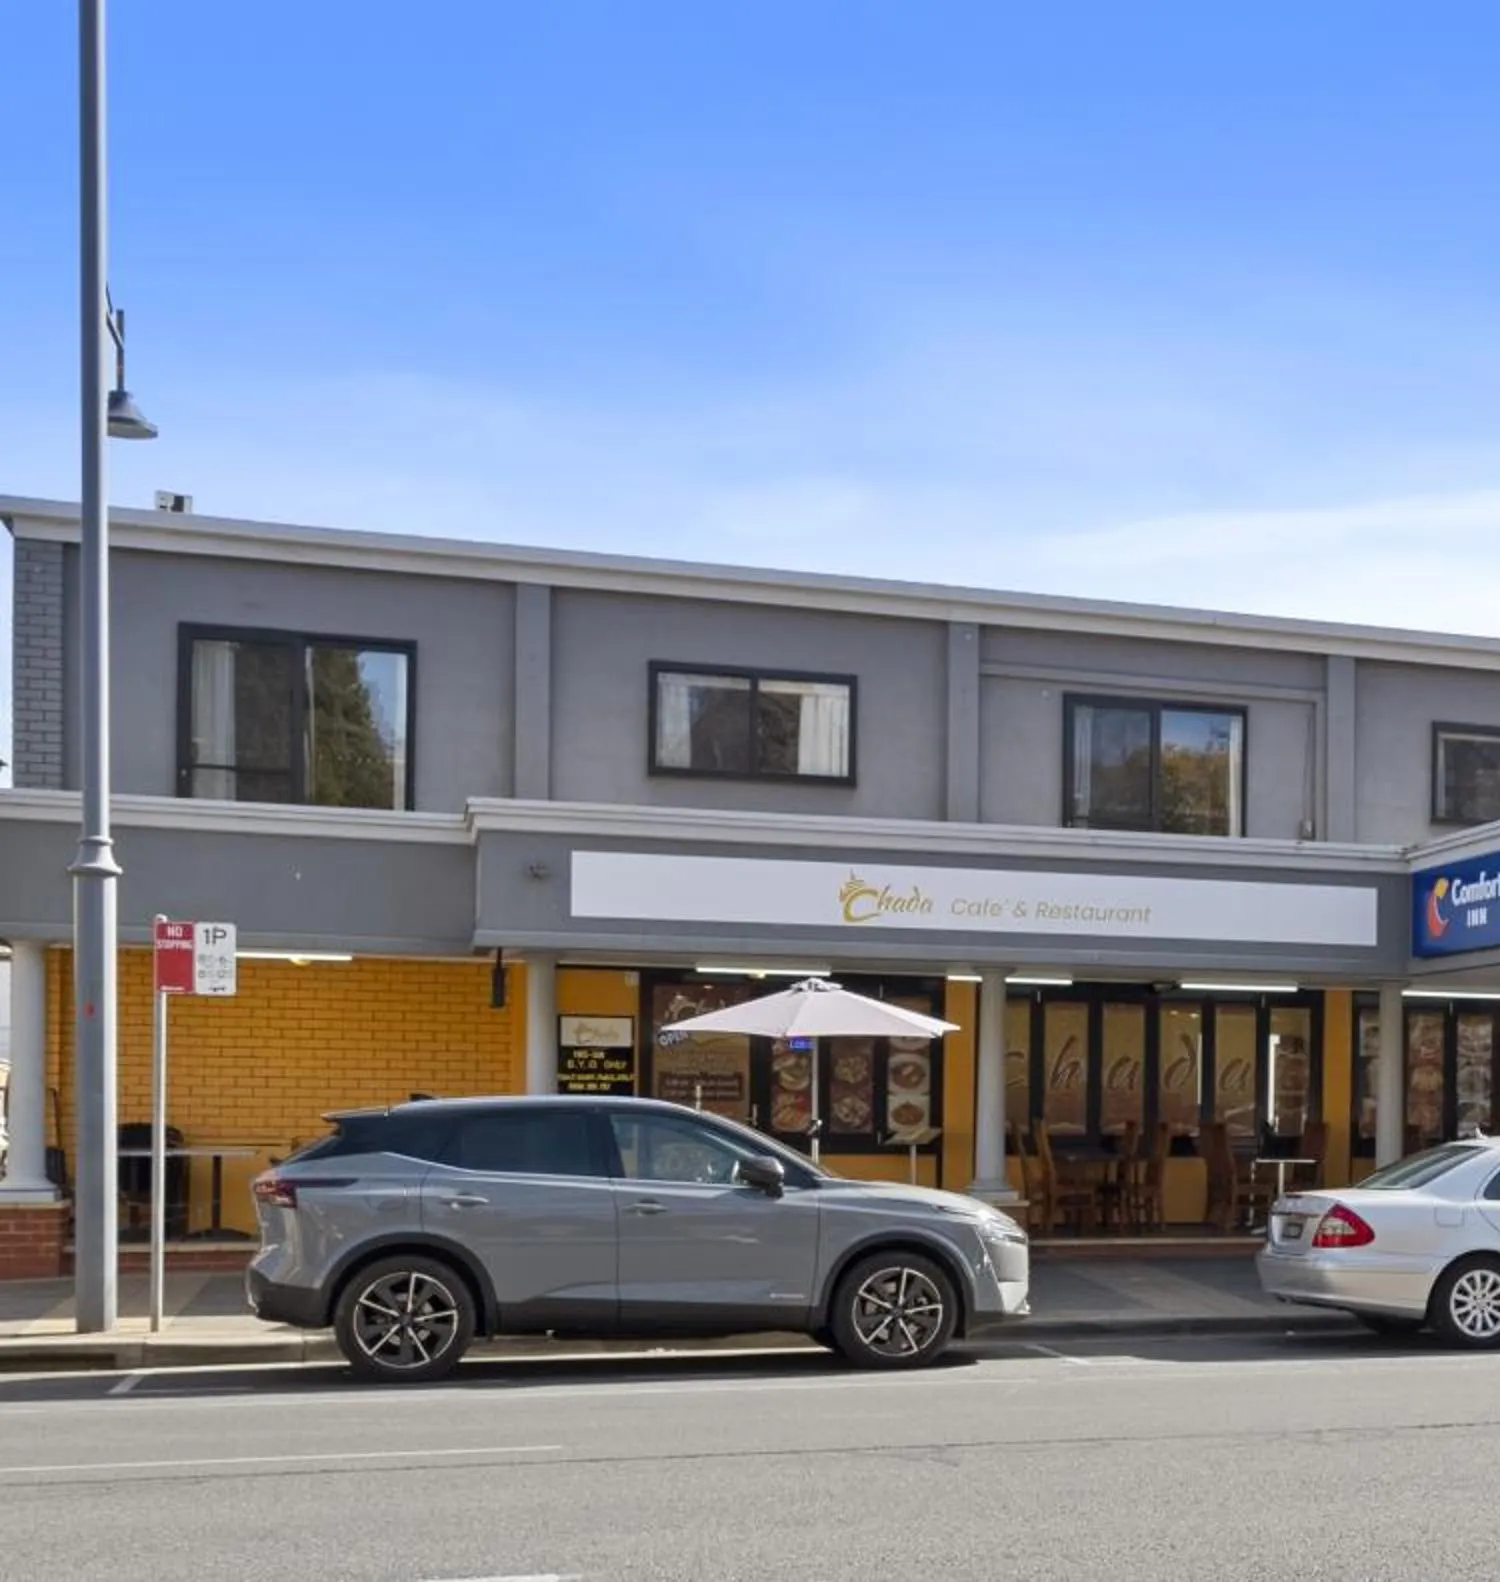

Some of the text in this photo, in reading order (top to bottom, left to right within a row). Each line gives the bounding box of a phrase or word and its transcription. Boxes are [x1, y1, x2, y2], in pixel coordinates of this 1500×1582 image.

[839, 868, 933, 923] Chada
[1013, 903, 1028, 919] &
[1035, 901, 1152, 923] Restaurant
[1466, 907, 1488, 928] INN
[166, 925, 183, 938] NO
[203, 926, 228, 946] 1P
